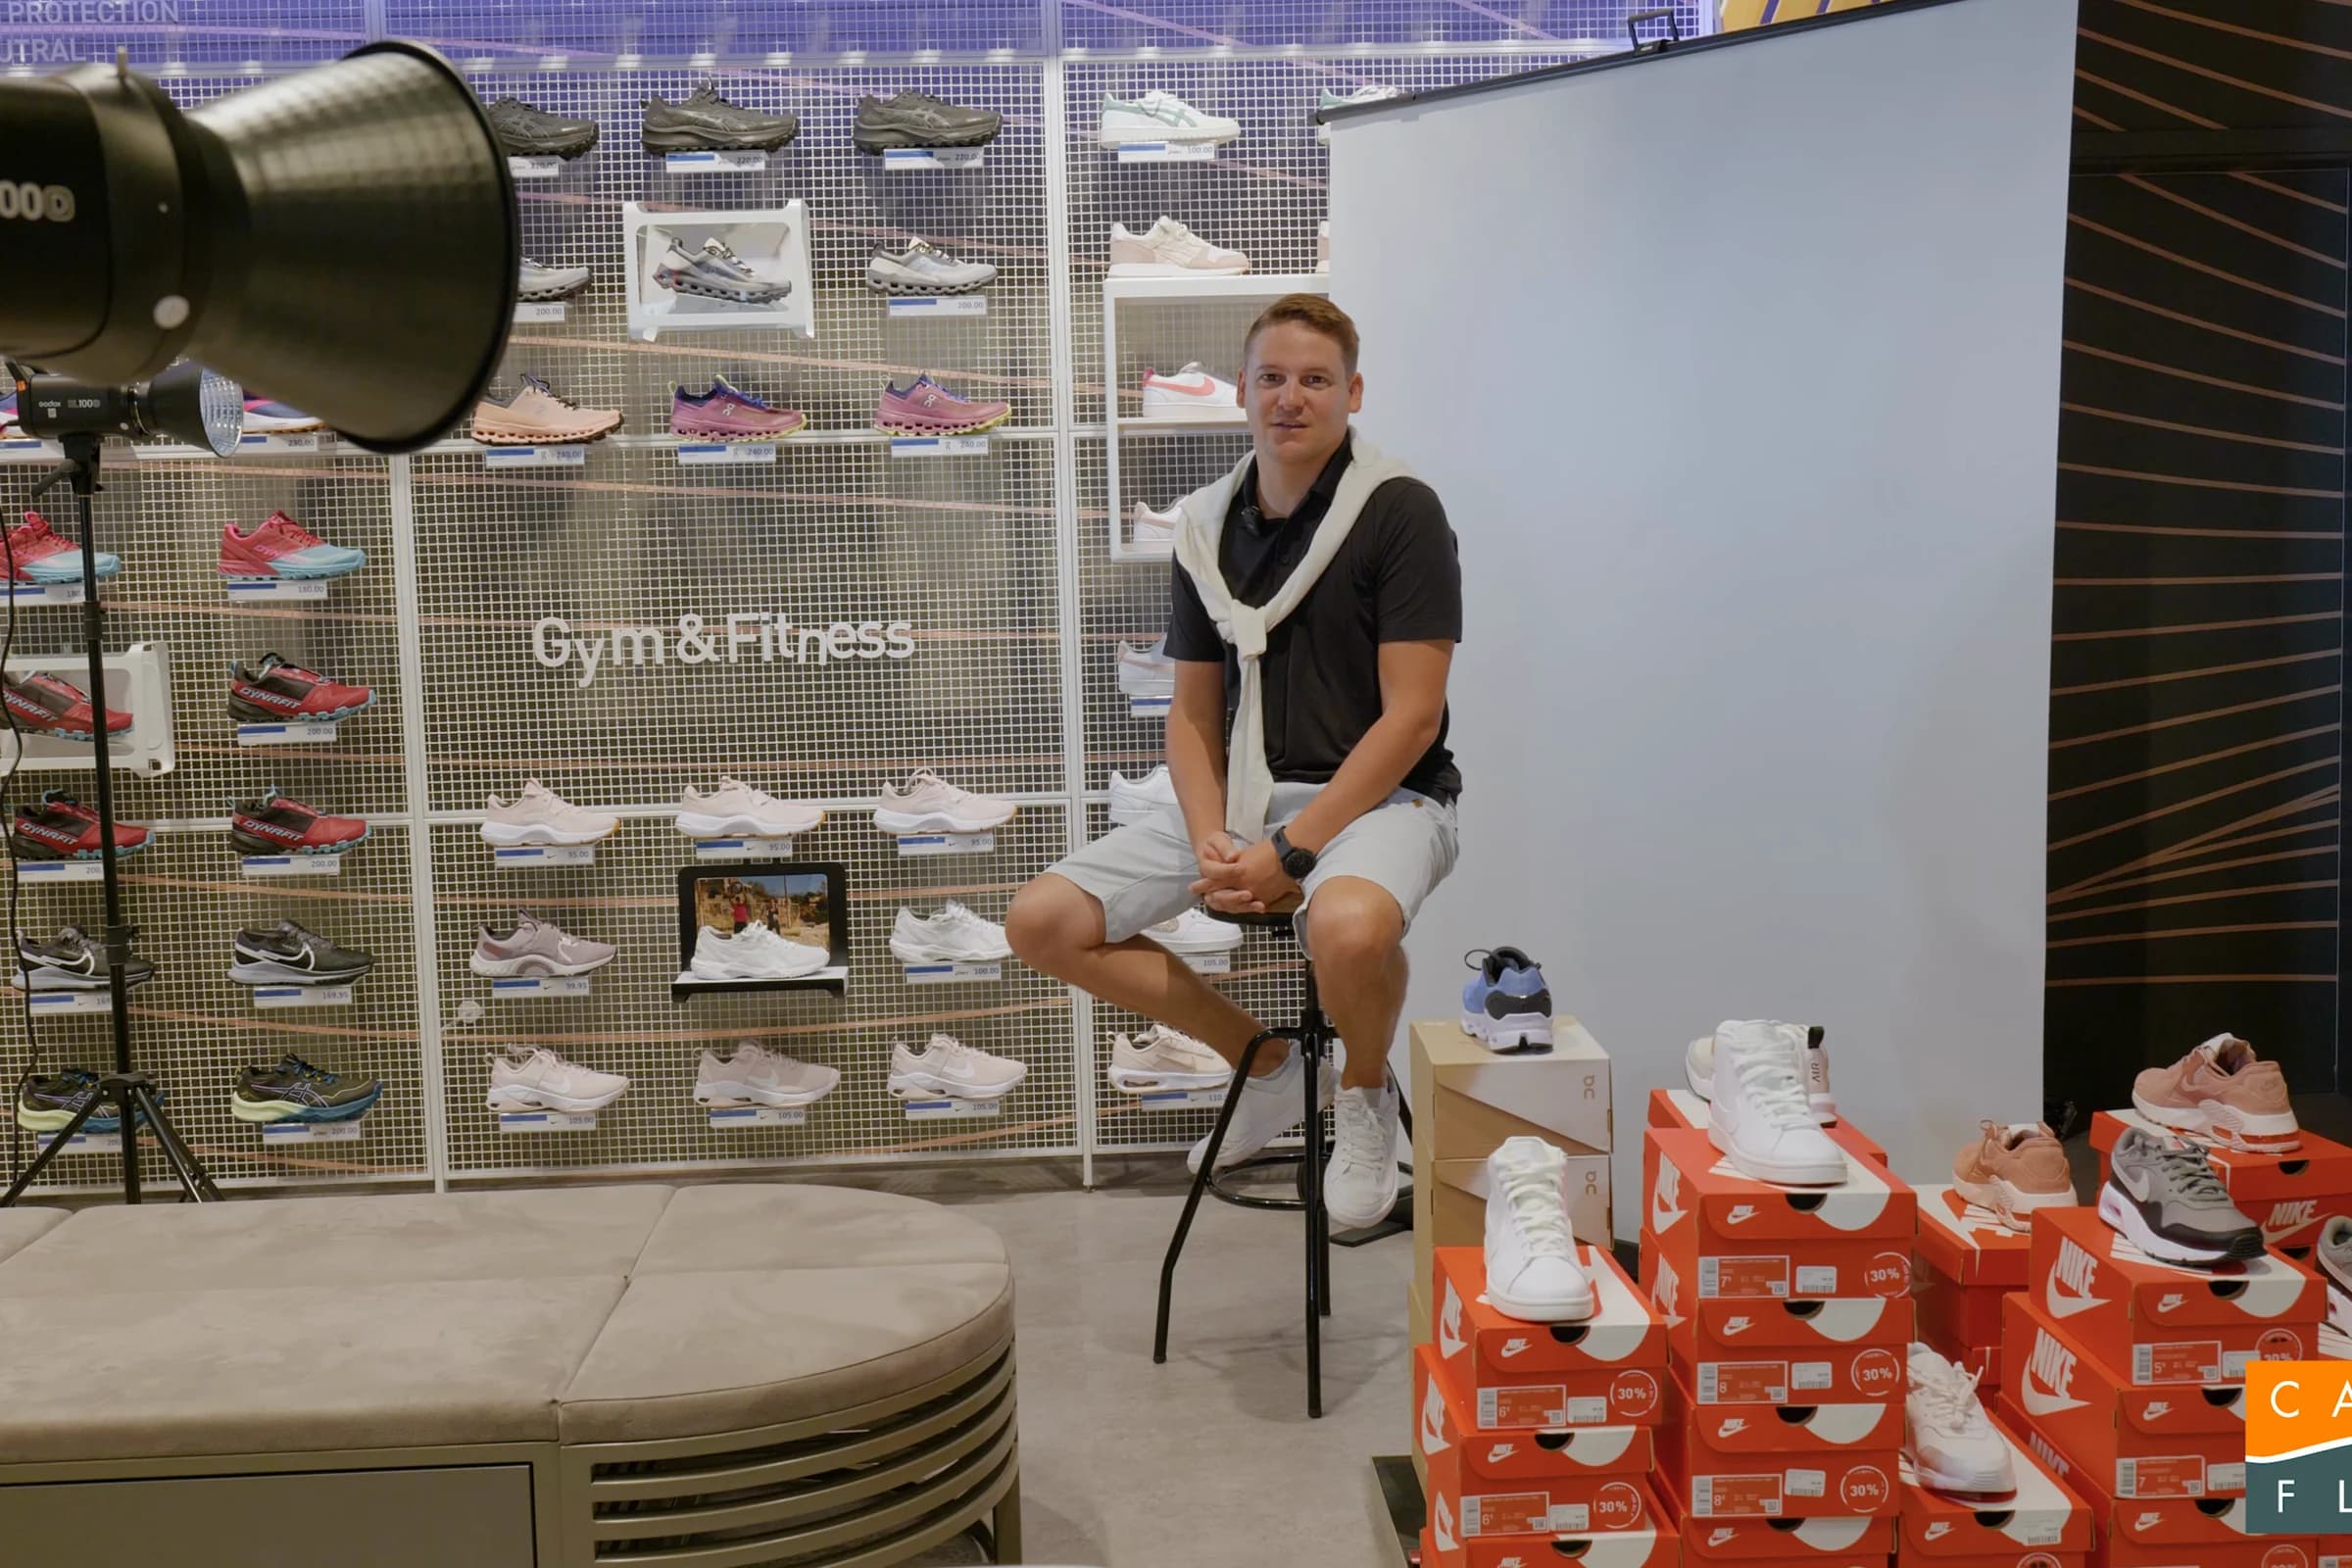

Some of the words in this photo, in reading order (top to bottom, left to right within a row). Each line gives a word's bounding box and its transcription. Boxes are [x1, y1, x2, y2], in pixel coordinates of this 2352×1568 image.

[9, 0, 180, 24] PROTECTION
[532, 616, 664, 687] Gym
[726, 612, 915, 666] Fitness
[239, 686, 302, 710] DYNAFIT
[22, 822, 79, 846] DYNAFIT
[243, 819, 305, 842] DYNAFIT
[1810, 1062, 1821, 1083] AIR
[2268, 1200, 2319, 1227] NIKE
[1870, 1267, 1901, 1283] 30%
[2055, 1235, 2098, 1299] NIKE
[1863, 1366, 1893, 1382] 30%
[2031, 1326, 2078, 1399] NIKE
[1618, 1387, 1646, 1399] 30%
[1849, 1484, 1880, 1497] 30%
[1598, 1500, 1628, 1513] 30%
